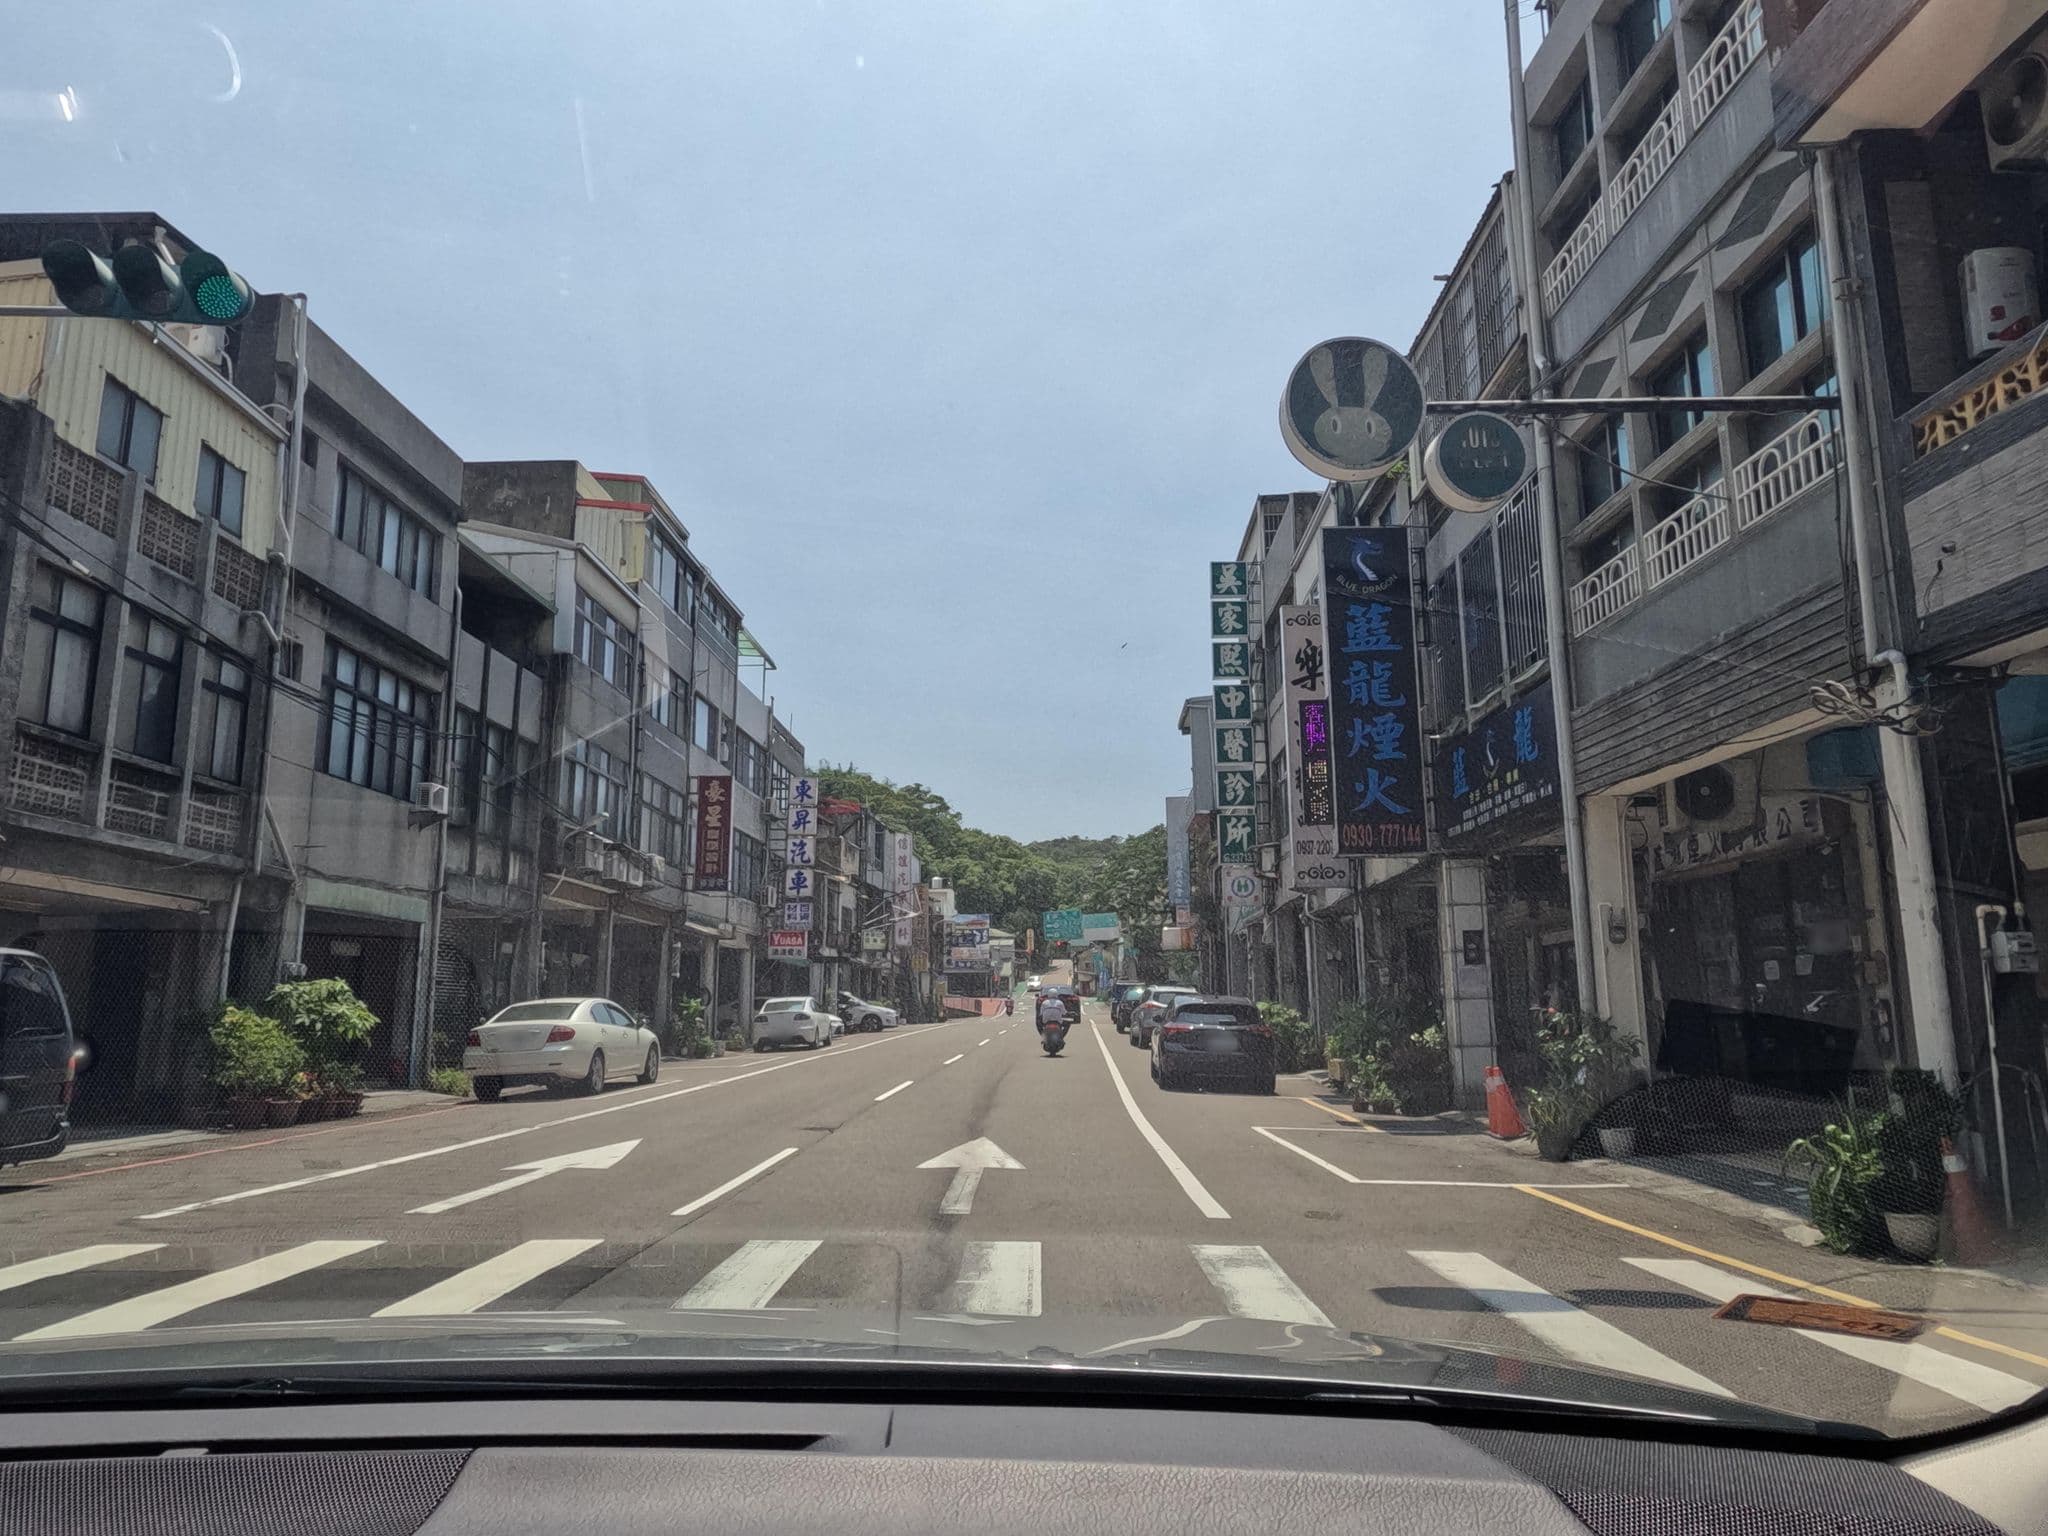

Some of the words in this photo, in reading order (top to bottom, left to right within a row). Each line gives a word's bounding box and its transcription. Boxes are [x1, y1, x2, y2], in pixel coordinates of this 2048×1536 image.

[1336, 574, 1358, 592] BLUE
[1361, 574, 1398, 594] DRAGON
[1215, 563, 1252, 852] 吳家熙中醫診所
[1341, 602, 1412, 815] 藍龍煙火
[788, 779, 812, 896] 東昇汽車
[1296, 839, 1334, 856] 0937-220
[772, 933, 803, 945] YUASA
